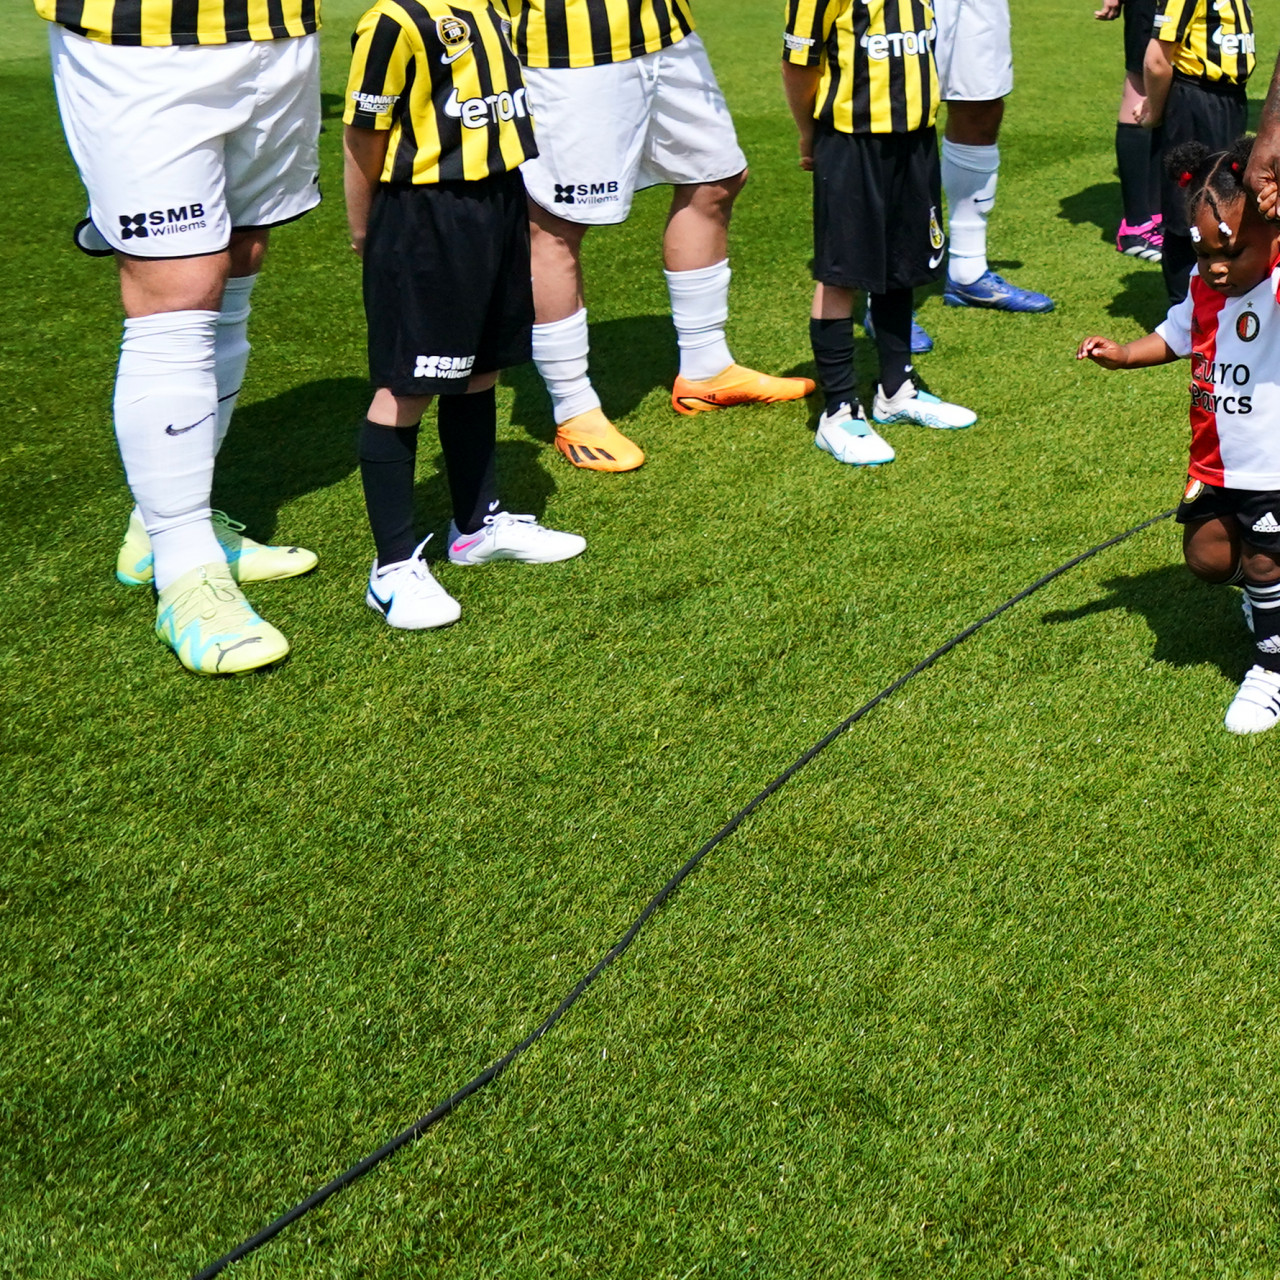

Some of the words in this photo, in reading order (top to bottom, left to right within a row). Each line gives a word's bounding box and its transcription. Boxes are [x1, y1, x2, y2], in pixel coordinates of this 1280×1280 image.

[577, 180, 619, 196] SMB
[576, 193, 620, 206] Willems
[148, 202, 205, 226] SMB
[150, 219, 207, 237] Willems
[437, 355, 476, 371] SMB
